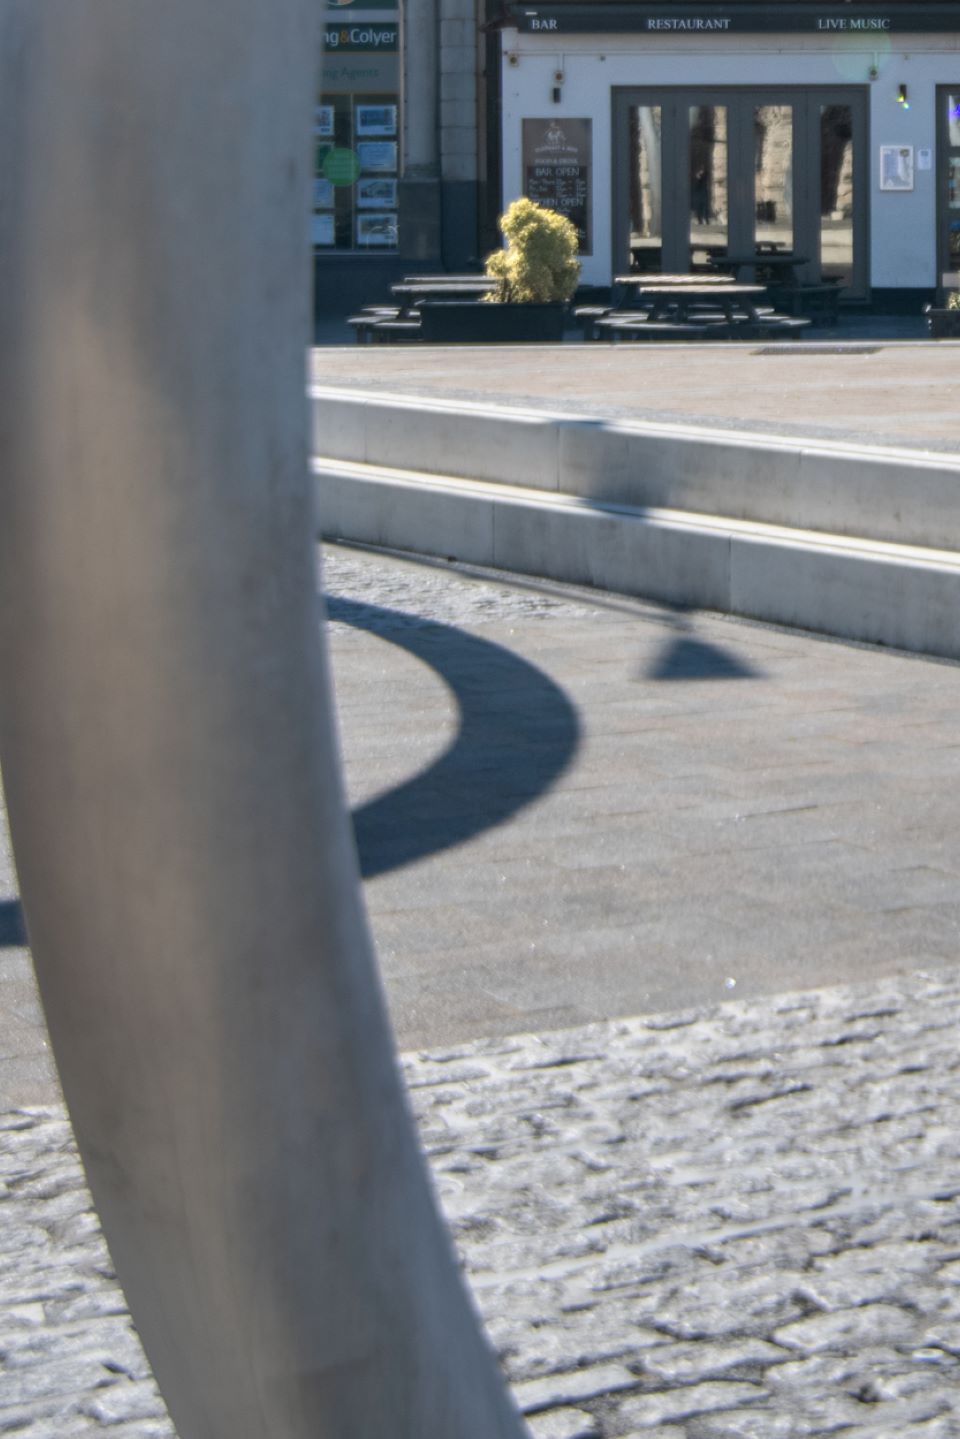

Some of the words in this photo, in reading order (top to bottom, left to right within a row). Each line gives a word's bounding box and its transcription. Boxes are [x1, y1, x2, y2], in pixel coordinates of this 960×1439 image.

[532, 19, 559, 30] BAR
[648, 19, 731, 30] RESTAURANT
[818, 19, 848, 29] LIVE
[850, 19, 891, 30] MUSIC
